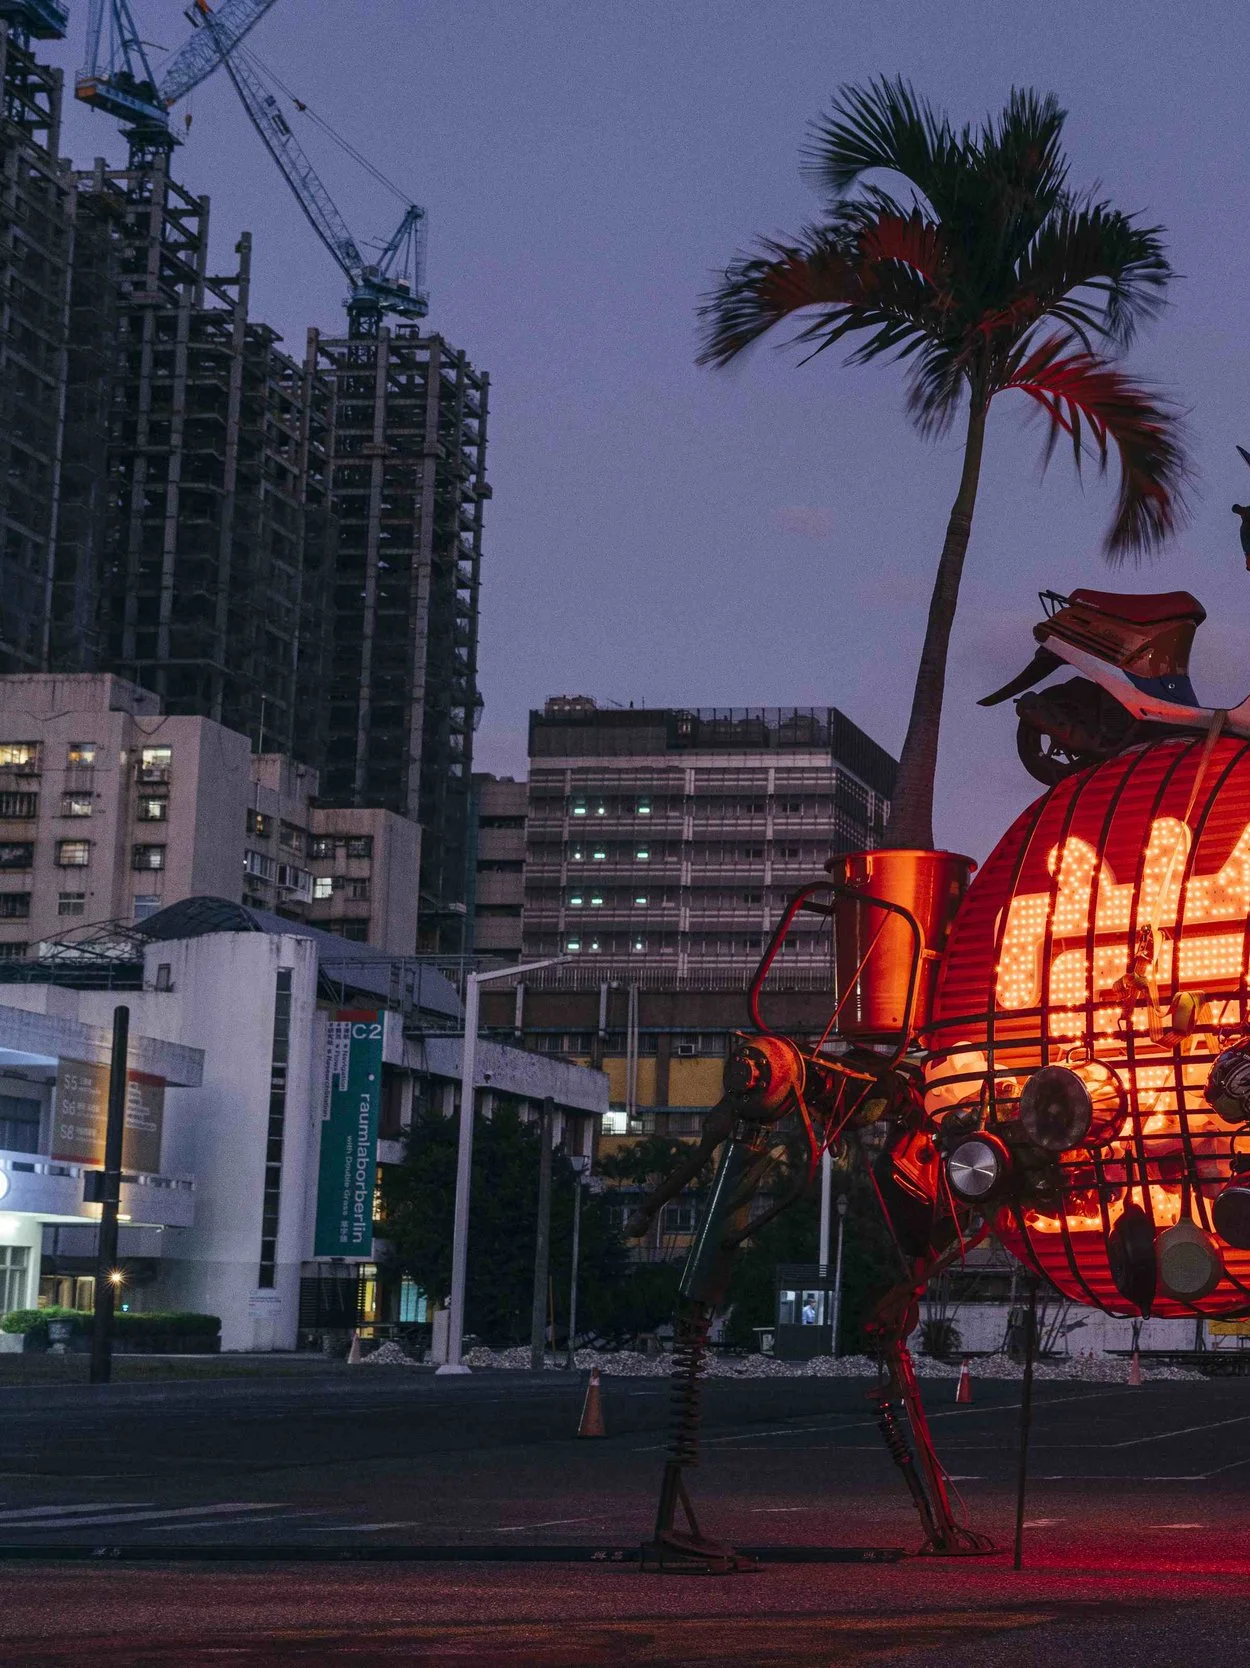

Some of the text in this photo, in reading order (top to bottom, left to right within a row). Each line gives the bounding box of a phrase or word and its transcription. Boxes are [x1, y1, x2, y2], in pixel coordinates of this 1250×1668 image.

[352, 1023, 382, 1040] C2
[64, 1074, 78, 1090] S5
[62, 1099, 76, 1116] S6
[60, 1124, 74, 1140] S8
[344, 1156, 352, 1188] Double
[352, 1093, 371, 1243] raumlaborberlin
